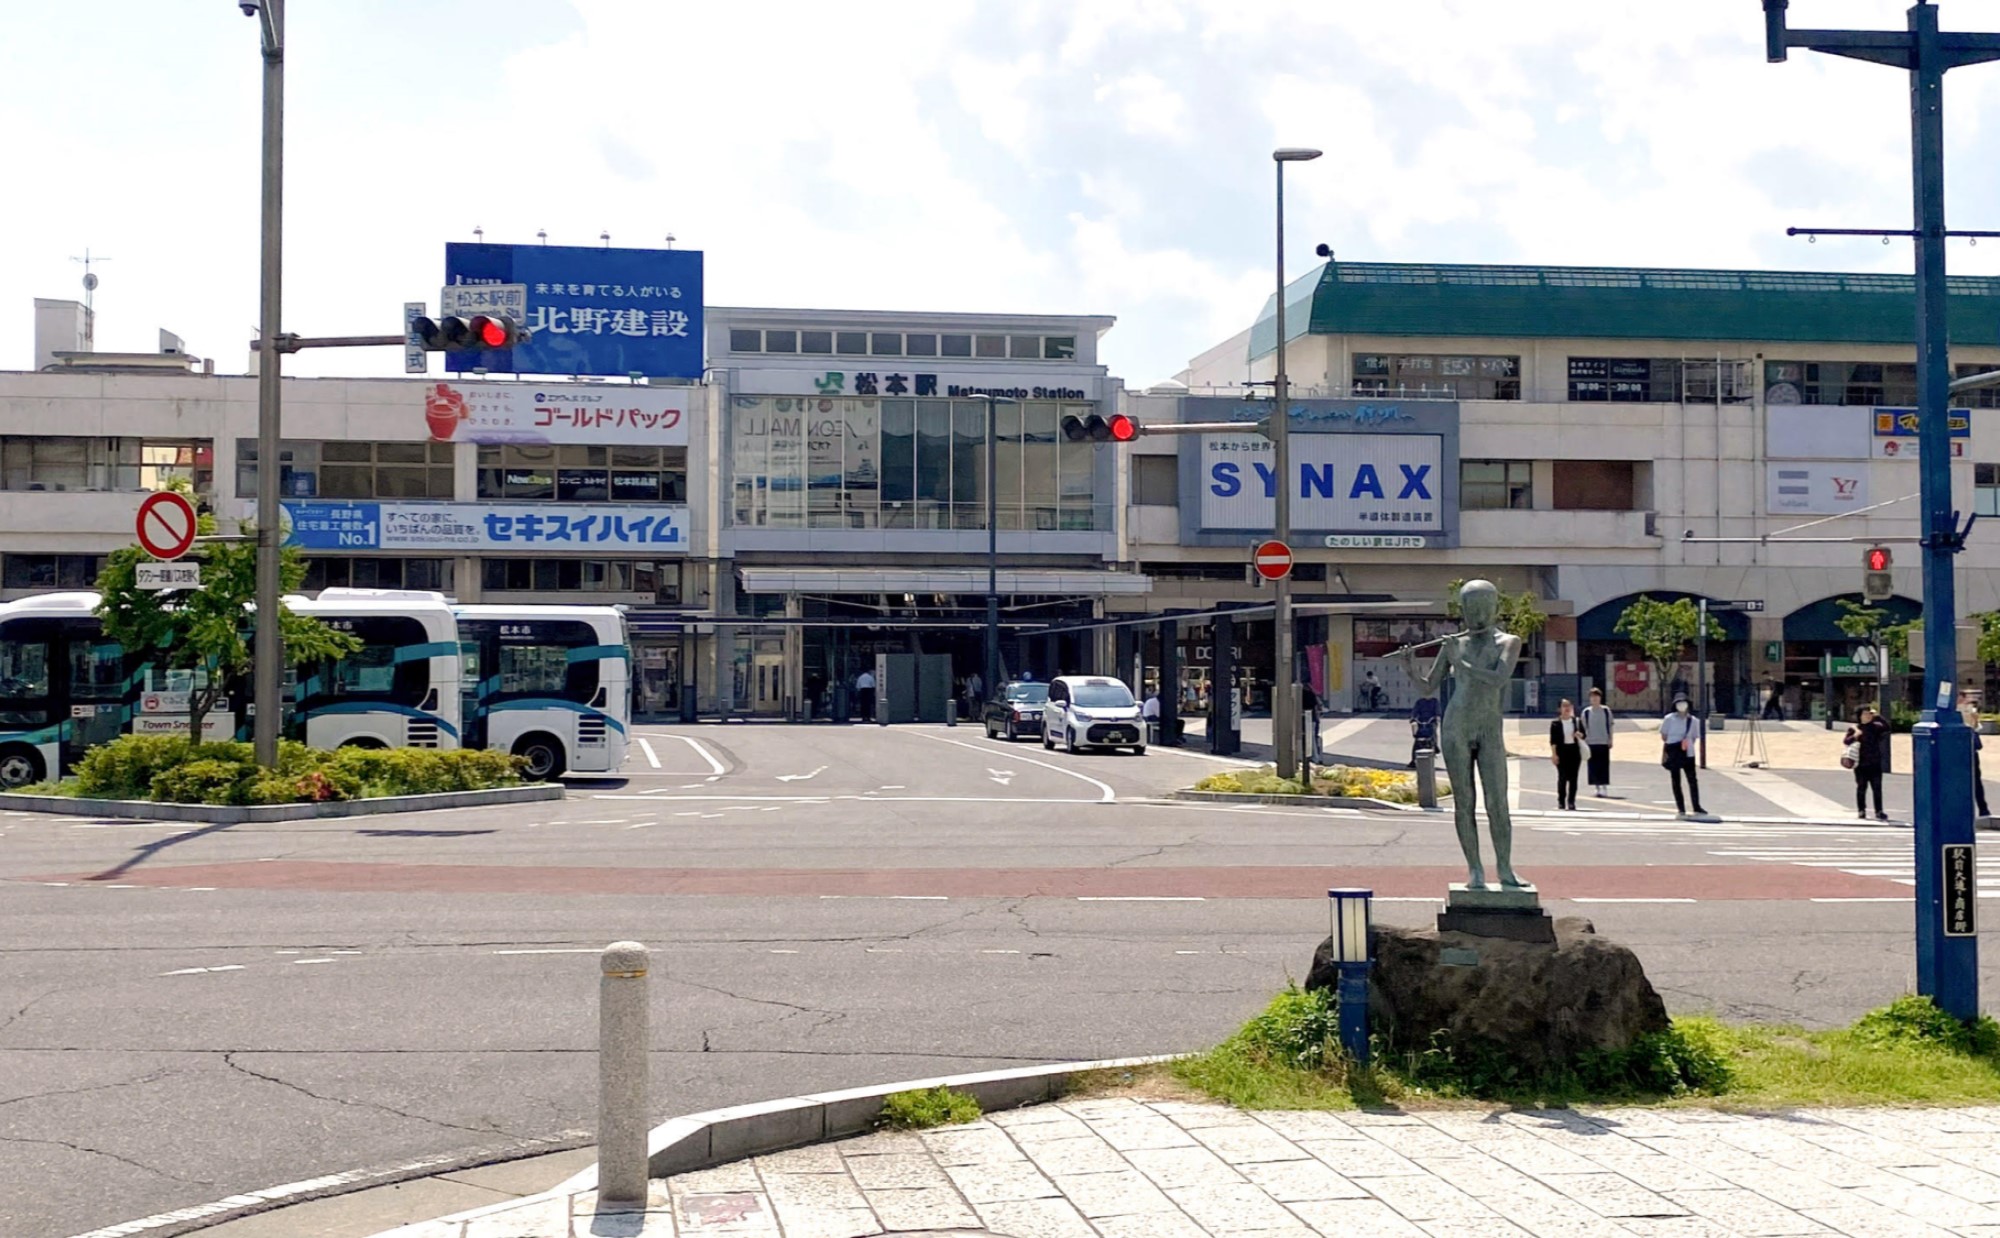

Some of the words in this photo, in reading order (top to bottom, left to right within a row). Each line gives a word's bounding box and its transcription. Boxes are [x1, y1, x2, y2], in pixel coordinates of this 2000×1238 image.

[457, 289, 522, 307] 松本駅前
[536, 283, 682, 298] 未来を育てる人がいる
[527, 305, 689, 337] 北野建設
[815, 371, 845, 389] JR
[855, 372, 938, 396] 松本駅
[947, 384, 1028, 399] Matsumoto
[1032, 386, 1085, 400] Station
[534, 407, 681, 429] ゴールドパック
[1210, 461, 1432, 499] SYNAX
[1831, 477, 1858, 494] Y!
[386, 512, 457, 524] すべての家に、
[386, 524, 480, 535] いちばんの品質を。
[483, 513, 679, 543] セキスイハイム
[1329, 537, 1421, 547] たのしい旅はJRで
[500, 625, 531, 635] 松本市
[1837, 665, 1857, 673] MOS
[142, 720, 171, 730] Town
